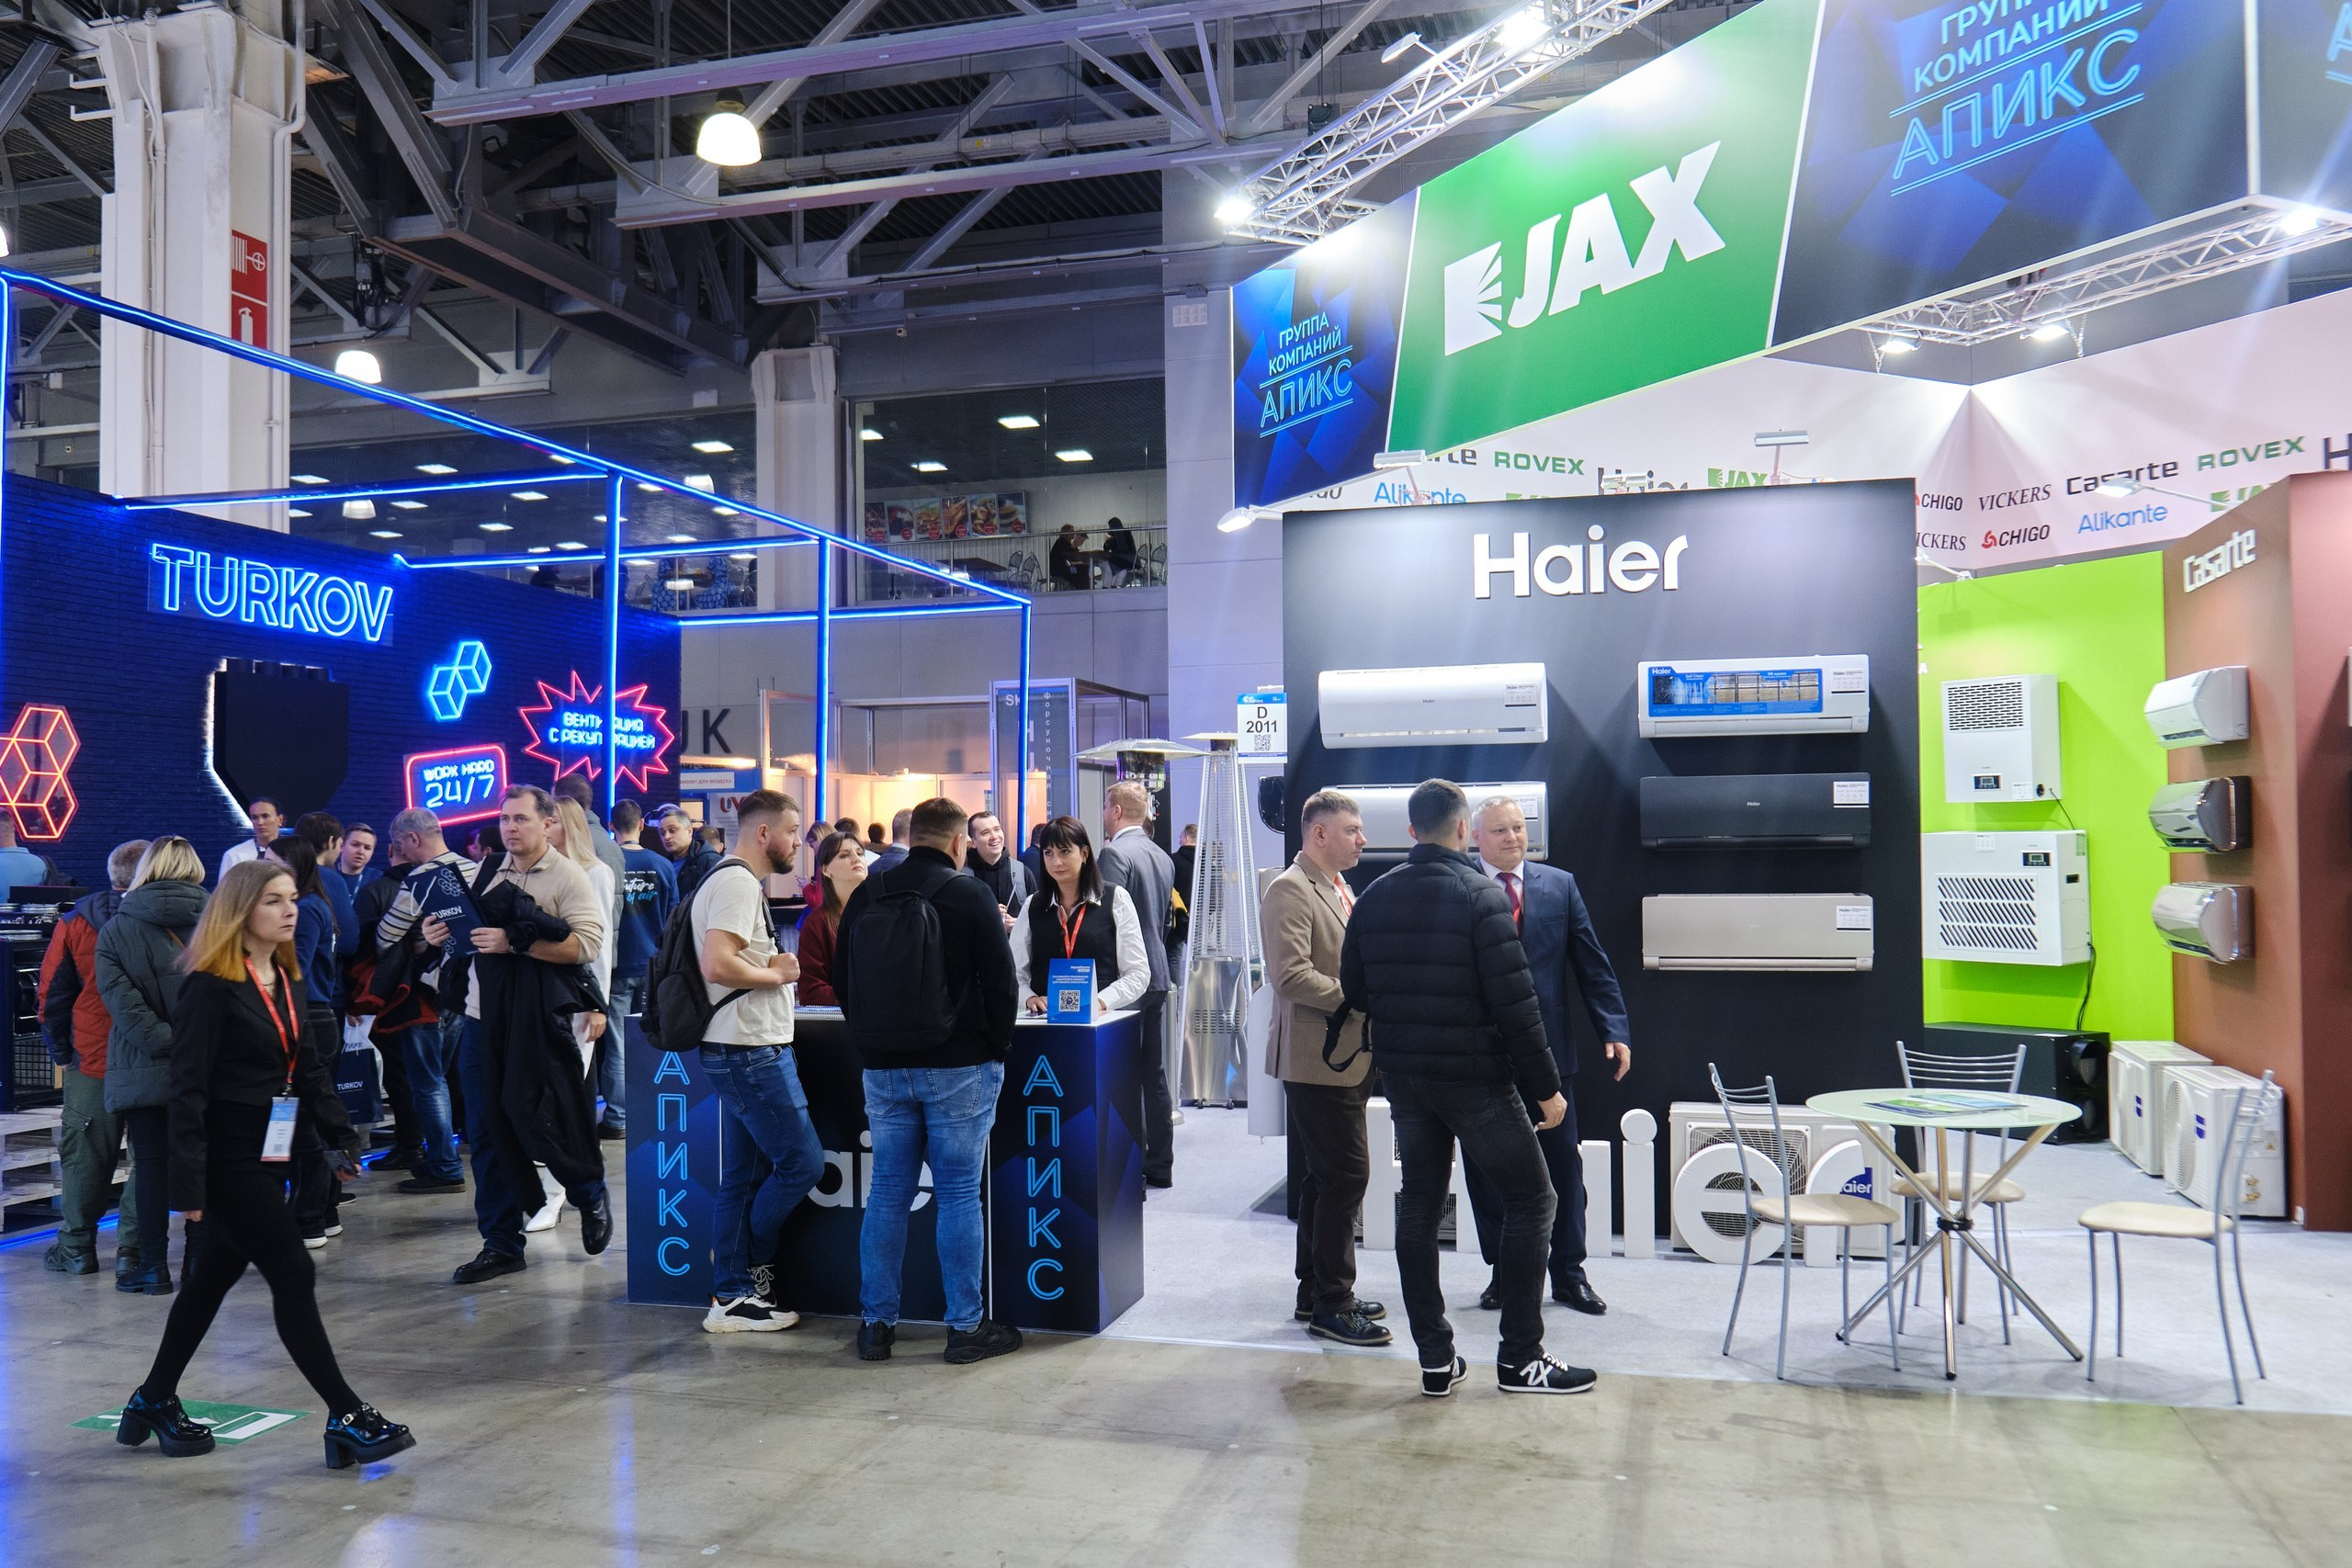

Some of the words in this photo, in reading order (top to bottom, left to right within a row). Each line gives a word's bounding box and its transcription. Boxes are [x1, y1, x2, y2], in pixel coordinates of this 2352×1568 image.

[1893, 28, 2142, 180] АПИКС
[1279, 311, 1329, 349] ГРУППА
[1269, 324, 1341, 376] КОМПАНИЙ
[1261, 358, 1352, 428] АПИКС
[1494, 451, 1585, 475] ROVEX
[2197, 436, 2305, 471] ROVEX
[1374, 482, 1467, 505] Aliknte
[1921, 493, 1963, 511] CHIGO
[1978, 484, 2052, 512] VICKERS
[2077, 503, 2169, 534] Alikante
[1916, 533, 1966, 551] ICKERS
[1998, 525, 2051, 547] CHIGO
[1474, 525, 1690, 599] Haier
[2183, 529, 2256, 593] Casarte
[152, 543, 393, 642] TURKOV
[1652, 667, 1672, 675] Haier
[1246, 720, 1277, 733] 2011
[1257, 706, 1268, 718] D
[423, 764, 458, 782] WORK
[461, 759, 495, 775] HARD
[425, 773, 495, 808] 24/7
[638, 891, 658, 900] air
[431, 905, 464, 919] TURKOV
[336, 1081, 364, 1091] TURKOV
[653, 1051, 691, 1277] АПИКС
[1023, 1055, 1065, 1301] АПИКС
[1363, 1097, 1865, 1268] Hier
[1842, 1180, 1872, 1194] aier
[1519, 1360, 1554, 1388] AX
